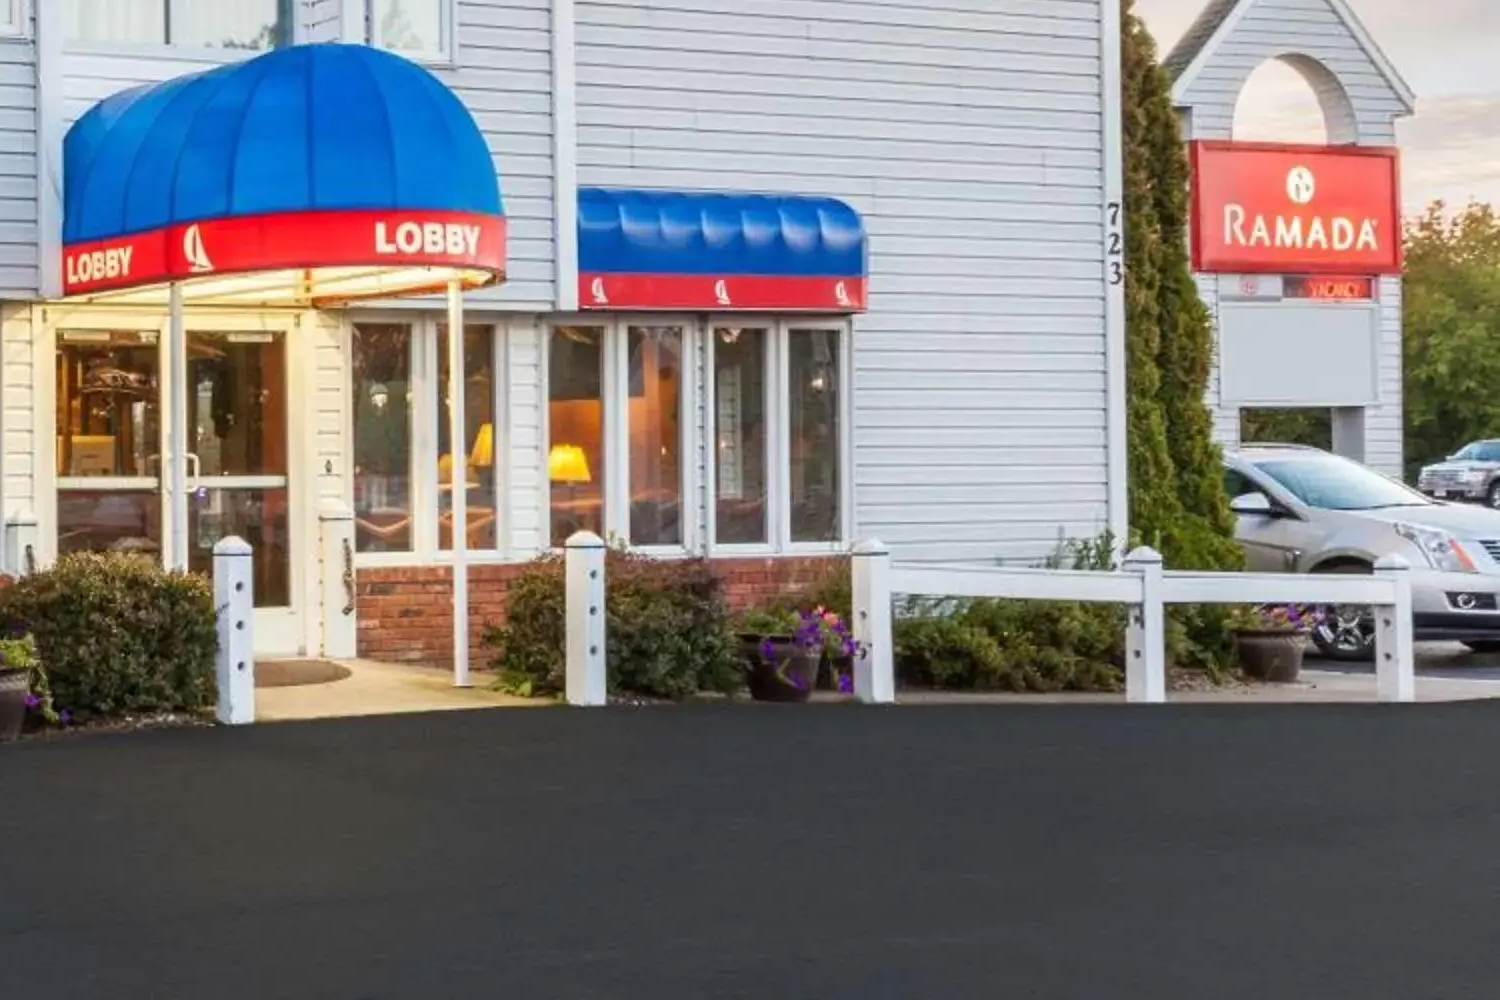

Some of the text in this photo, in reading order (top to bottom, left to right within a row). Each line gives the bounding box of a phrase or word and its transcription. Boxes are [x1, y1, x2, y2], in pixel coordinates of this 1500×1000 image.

[375, 220, 481, 256] LOBBY
[1107, 202, 1122, 285] 723
[1223, 203, 1379, 251] RAMADA
[67, 245, 133, 285] LOBBY
[1308, 280, 1362, 298] VACANCY
